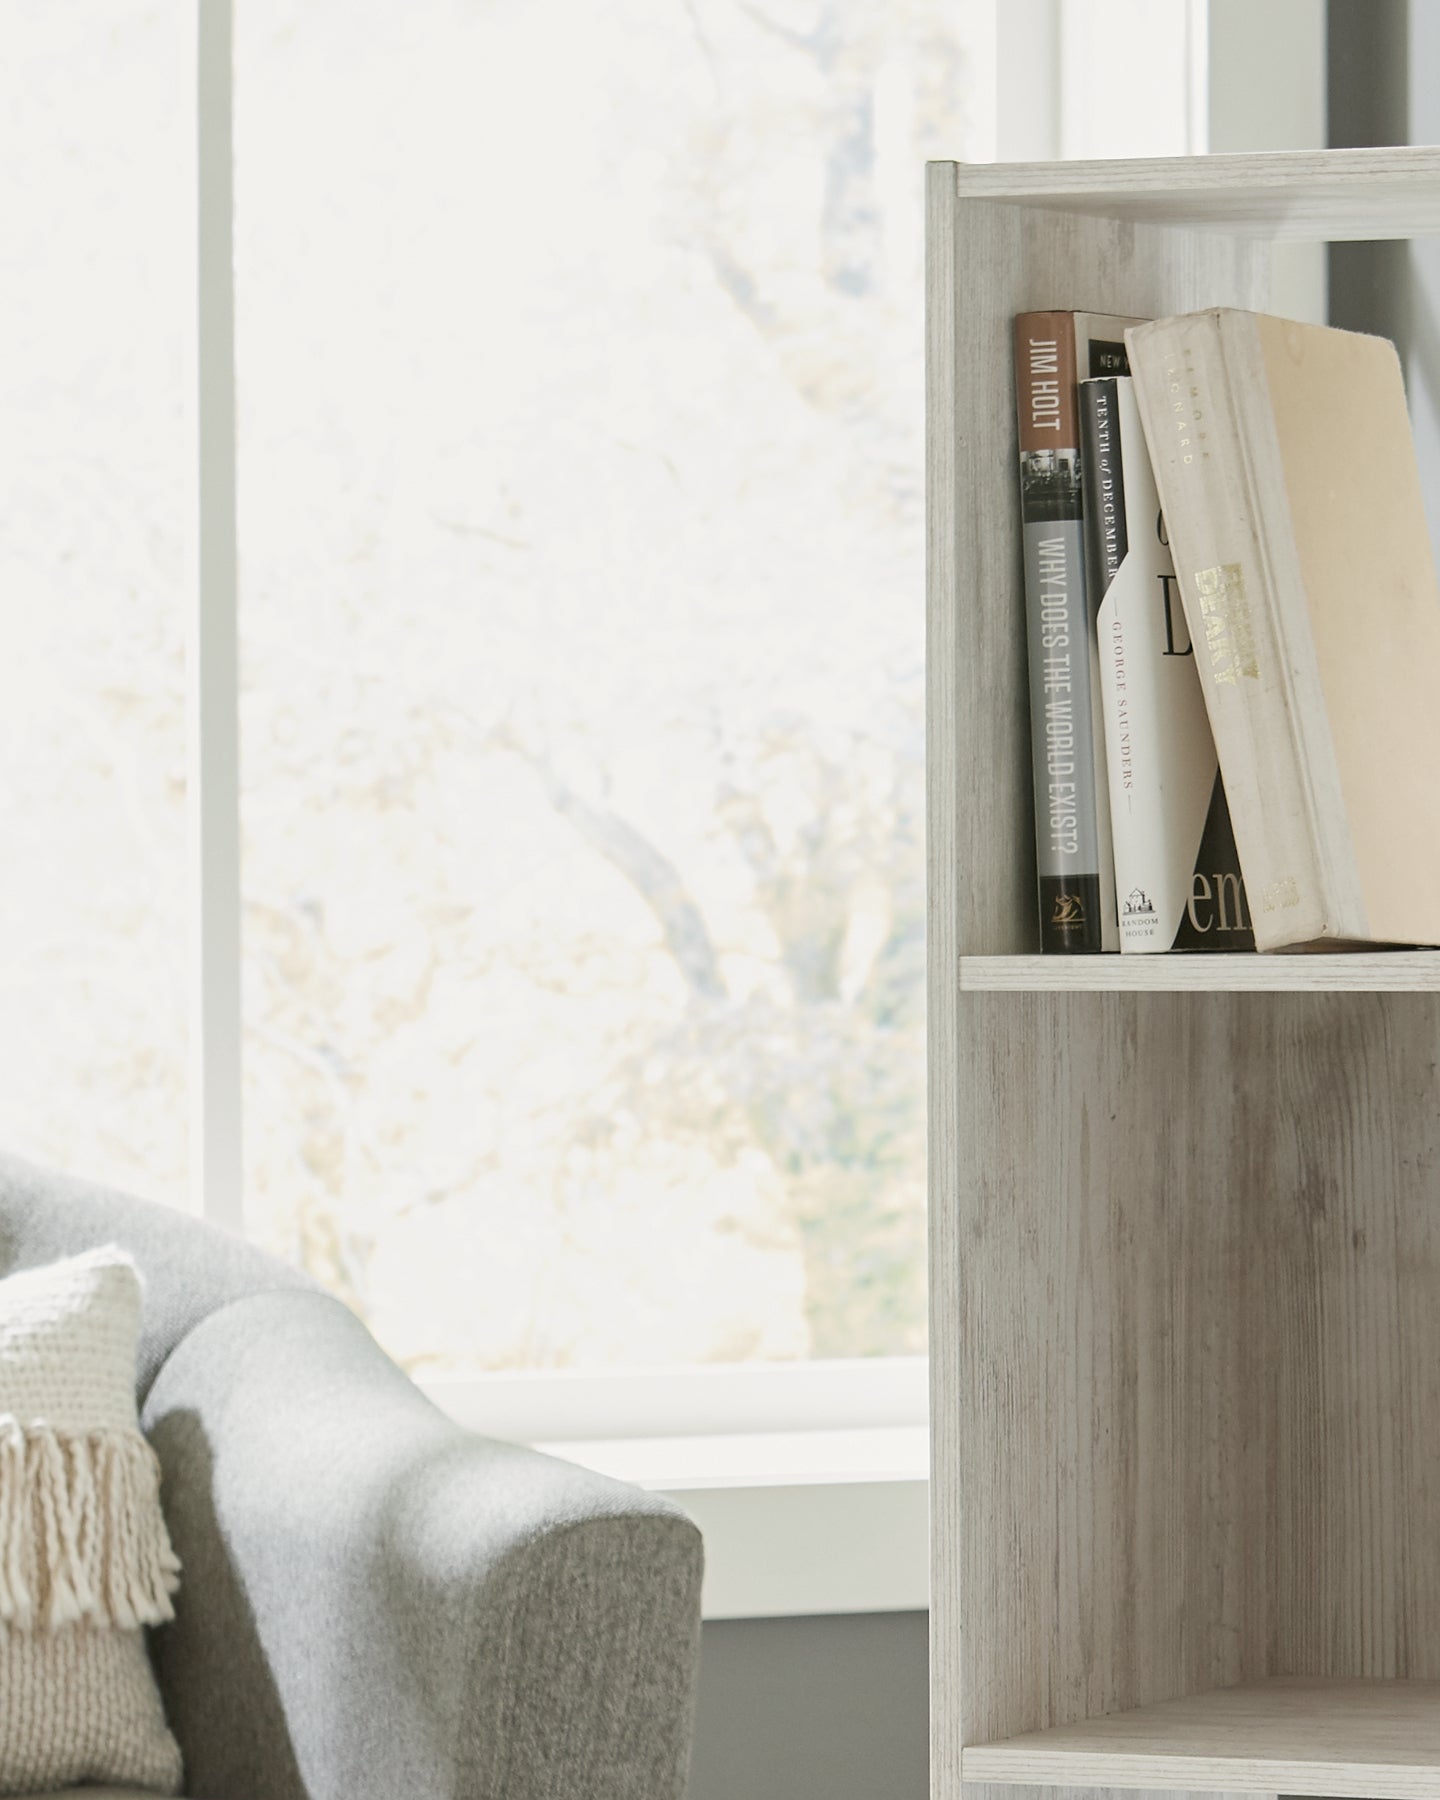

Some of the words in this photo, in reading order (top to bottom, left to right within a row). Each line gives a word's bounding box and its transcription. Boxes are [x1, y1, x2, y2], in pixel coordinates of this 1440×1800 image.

[1029, 339, 1058, 375] JIM
[1031, 380, 1061, 431] HOLT
[1096, 395, 1111, 454] TENTH
[1099, 458, 1112, 475] of
[1101, 479, 1118, 579] DECEMBER
[1038, 537, 1067, 587] WHY
[1040, 593, 1069, 648] DOES
[1042, 653, 1072, 694] THE
[1112, 621, 1128, 692] GEORGE
[1044, 699, 1074, 777] WORLD
[1117, 699, 1133, 790] SAUNDERS
[1048, 782, 1079, 855] EXIST?
[1121, 917, 1160, 928] RANDOM
[1125, 928, 1155, 938] HOUSE
